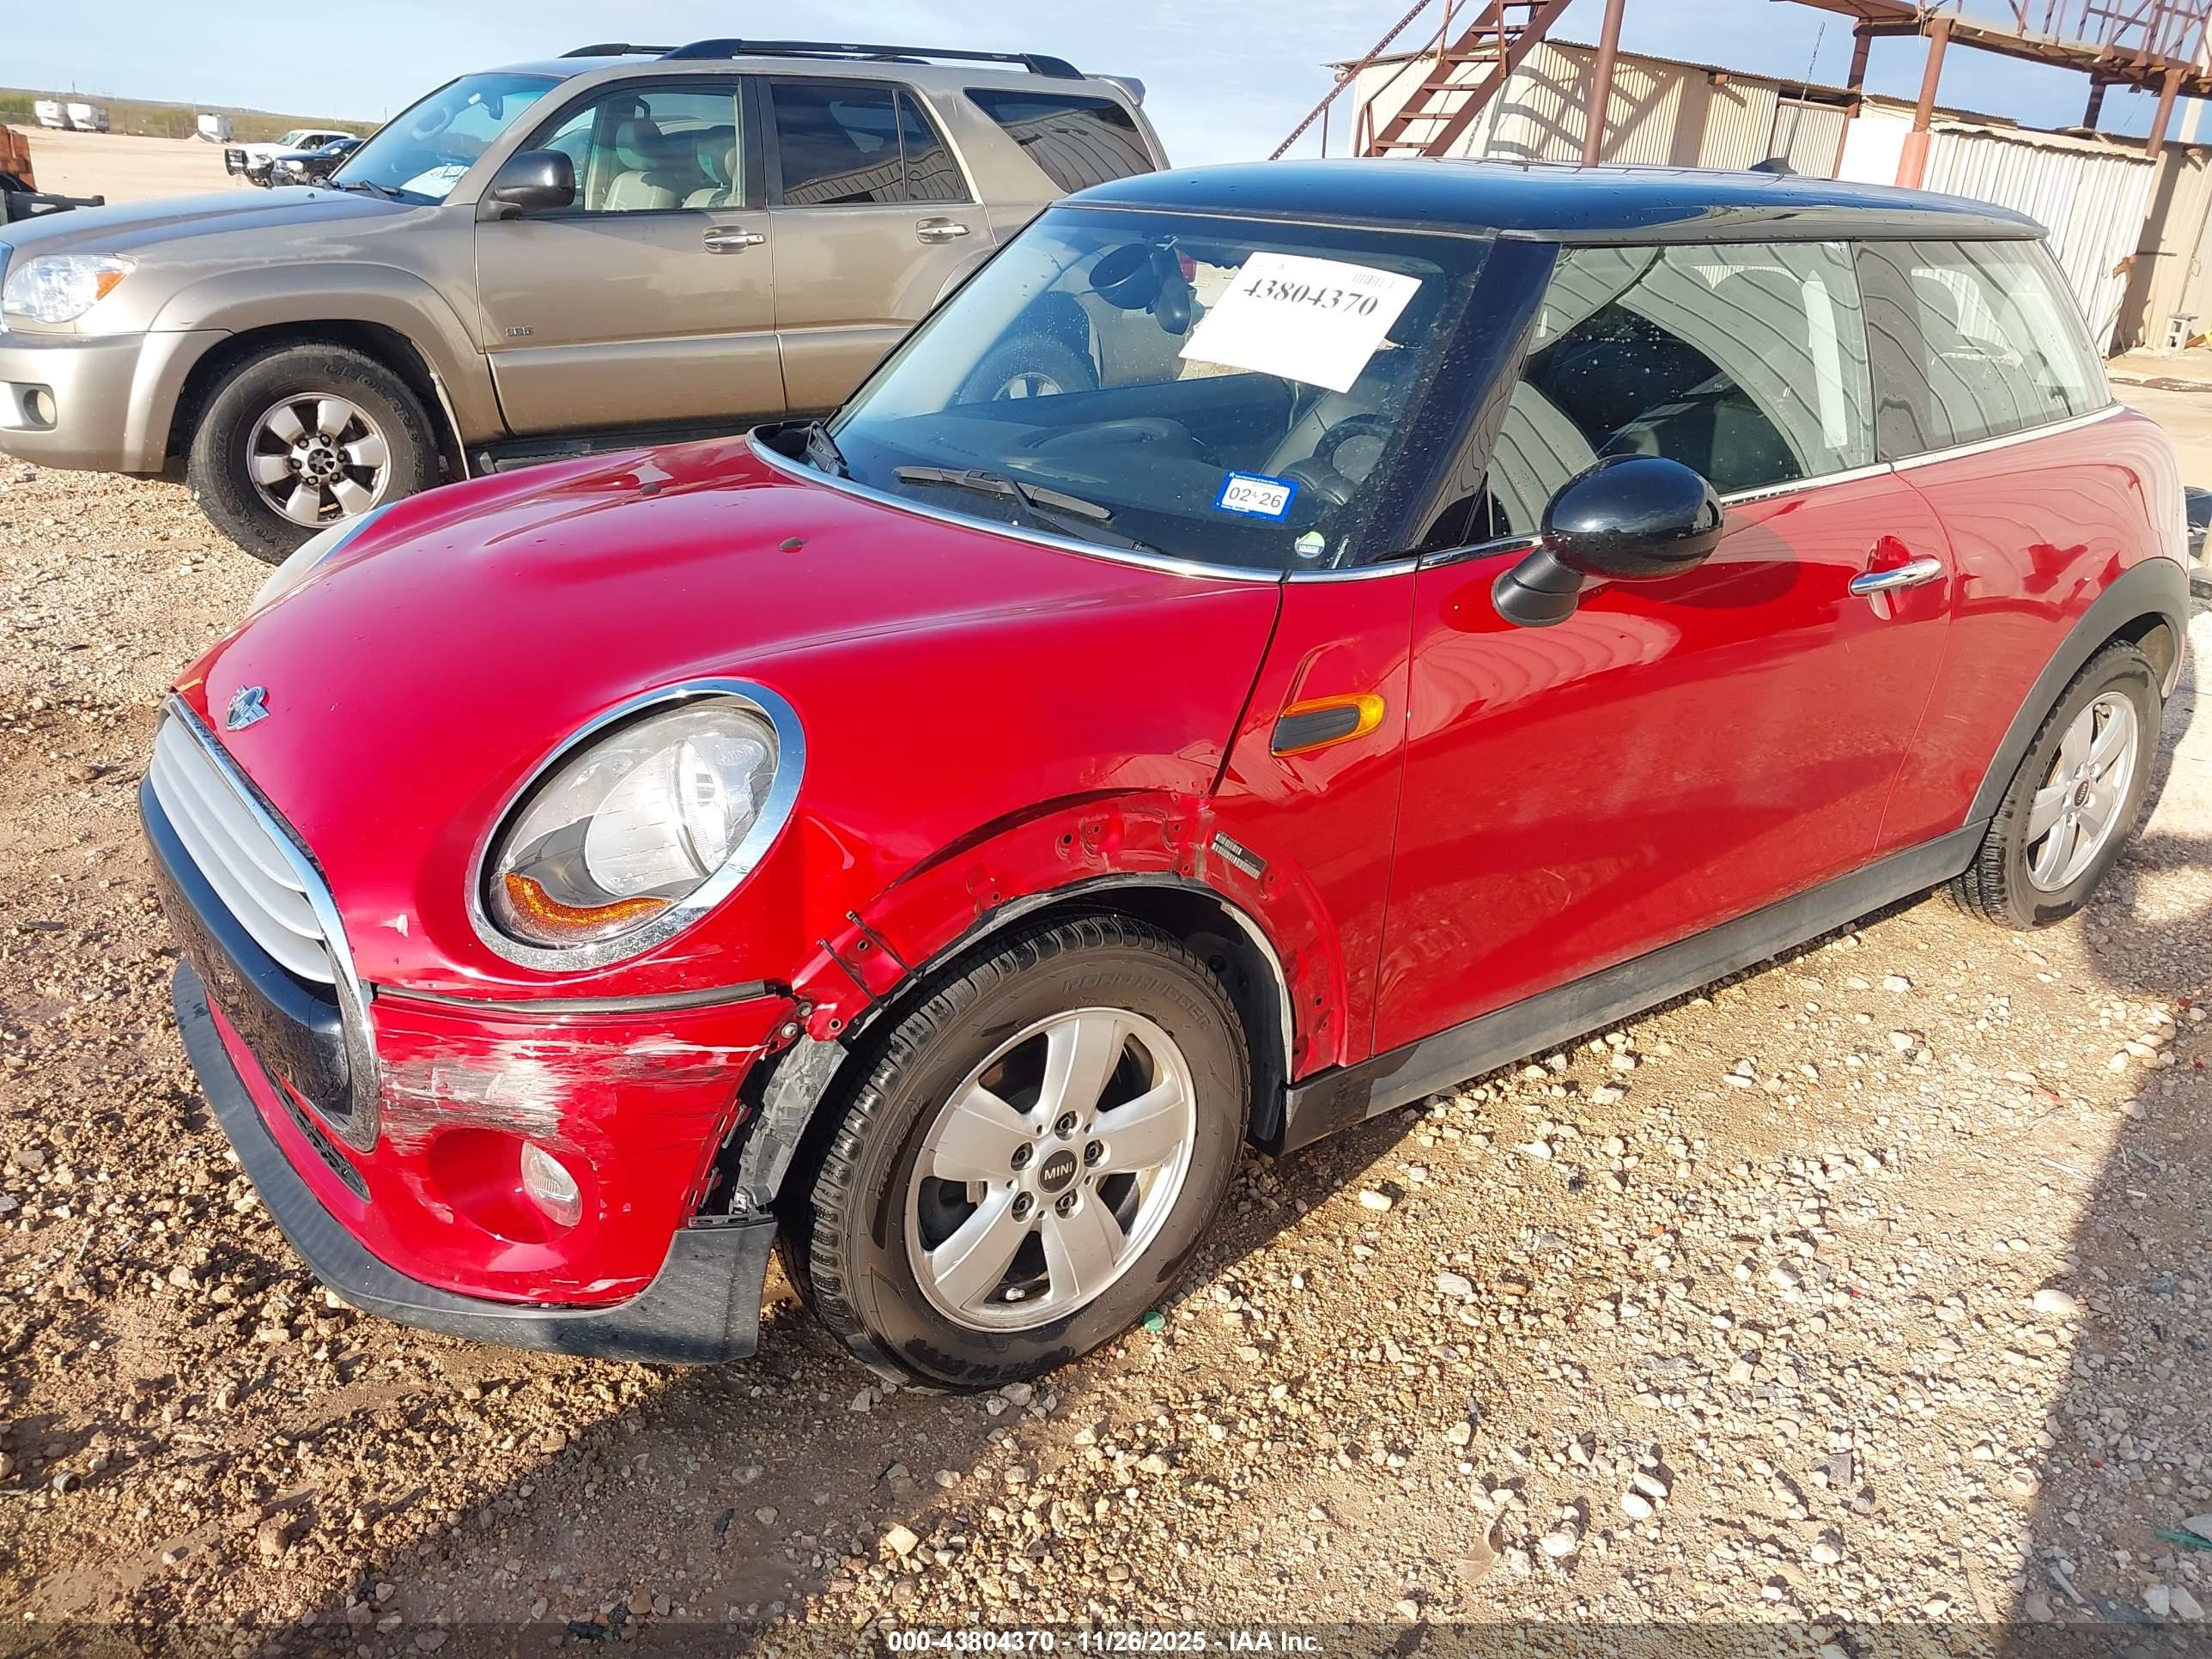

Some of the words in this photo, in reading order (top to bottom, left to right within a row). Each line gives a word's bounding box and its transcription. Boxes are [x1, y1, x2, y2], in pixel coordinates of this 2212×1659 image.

[1243, 277, 1379, 317] 43804370
[2077, 782, 2087, 803] MINI
[1044, 1161, 1073, 1181] MINI
